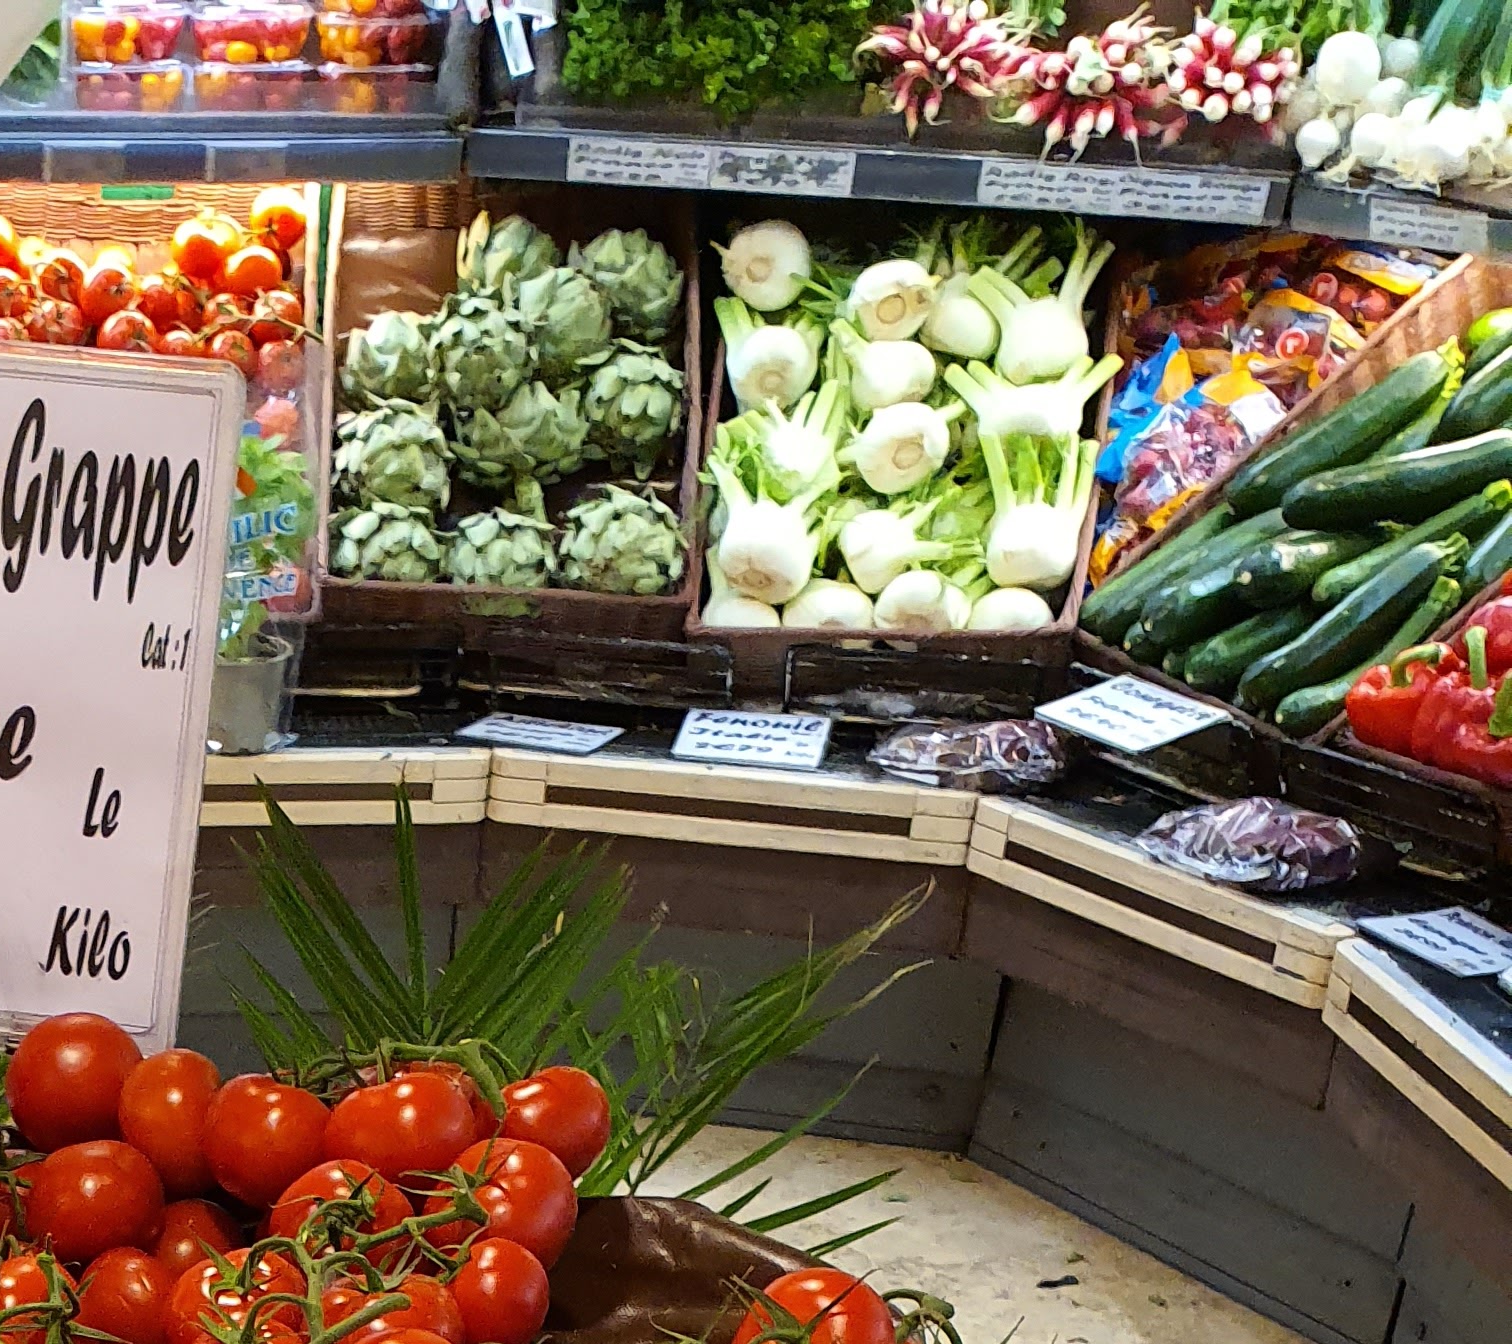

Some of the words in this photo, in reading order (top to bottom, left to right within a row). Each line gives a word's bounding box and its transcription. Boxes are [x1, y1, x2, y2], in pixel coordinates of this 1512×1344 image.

[1, 398, 200, 604] Grappe
[232, 503, 297, 544] ILIC
[82, 767, 122, 839] Le
[39, 905, 131, 981] Kilo
